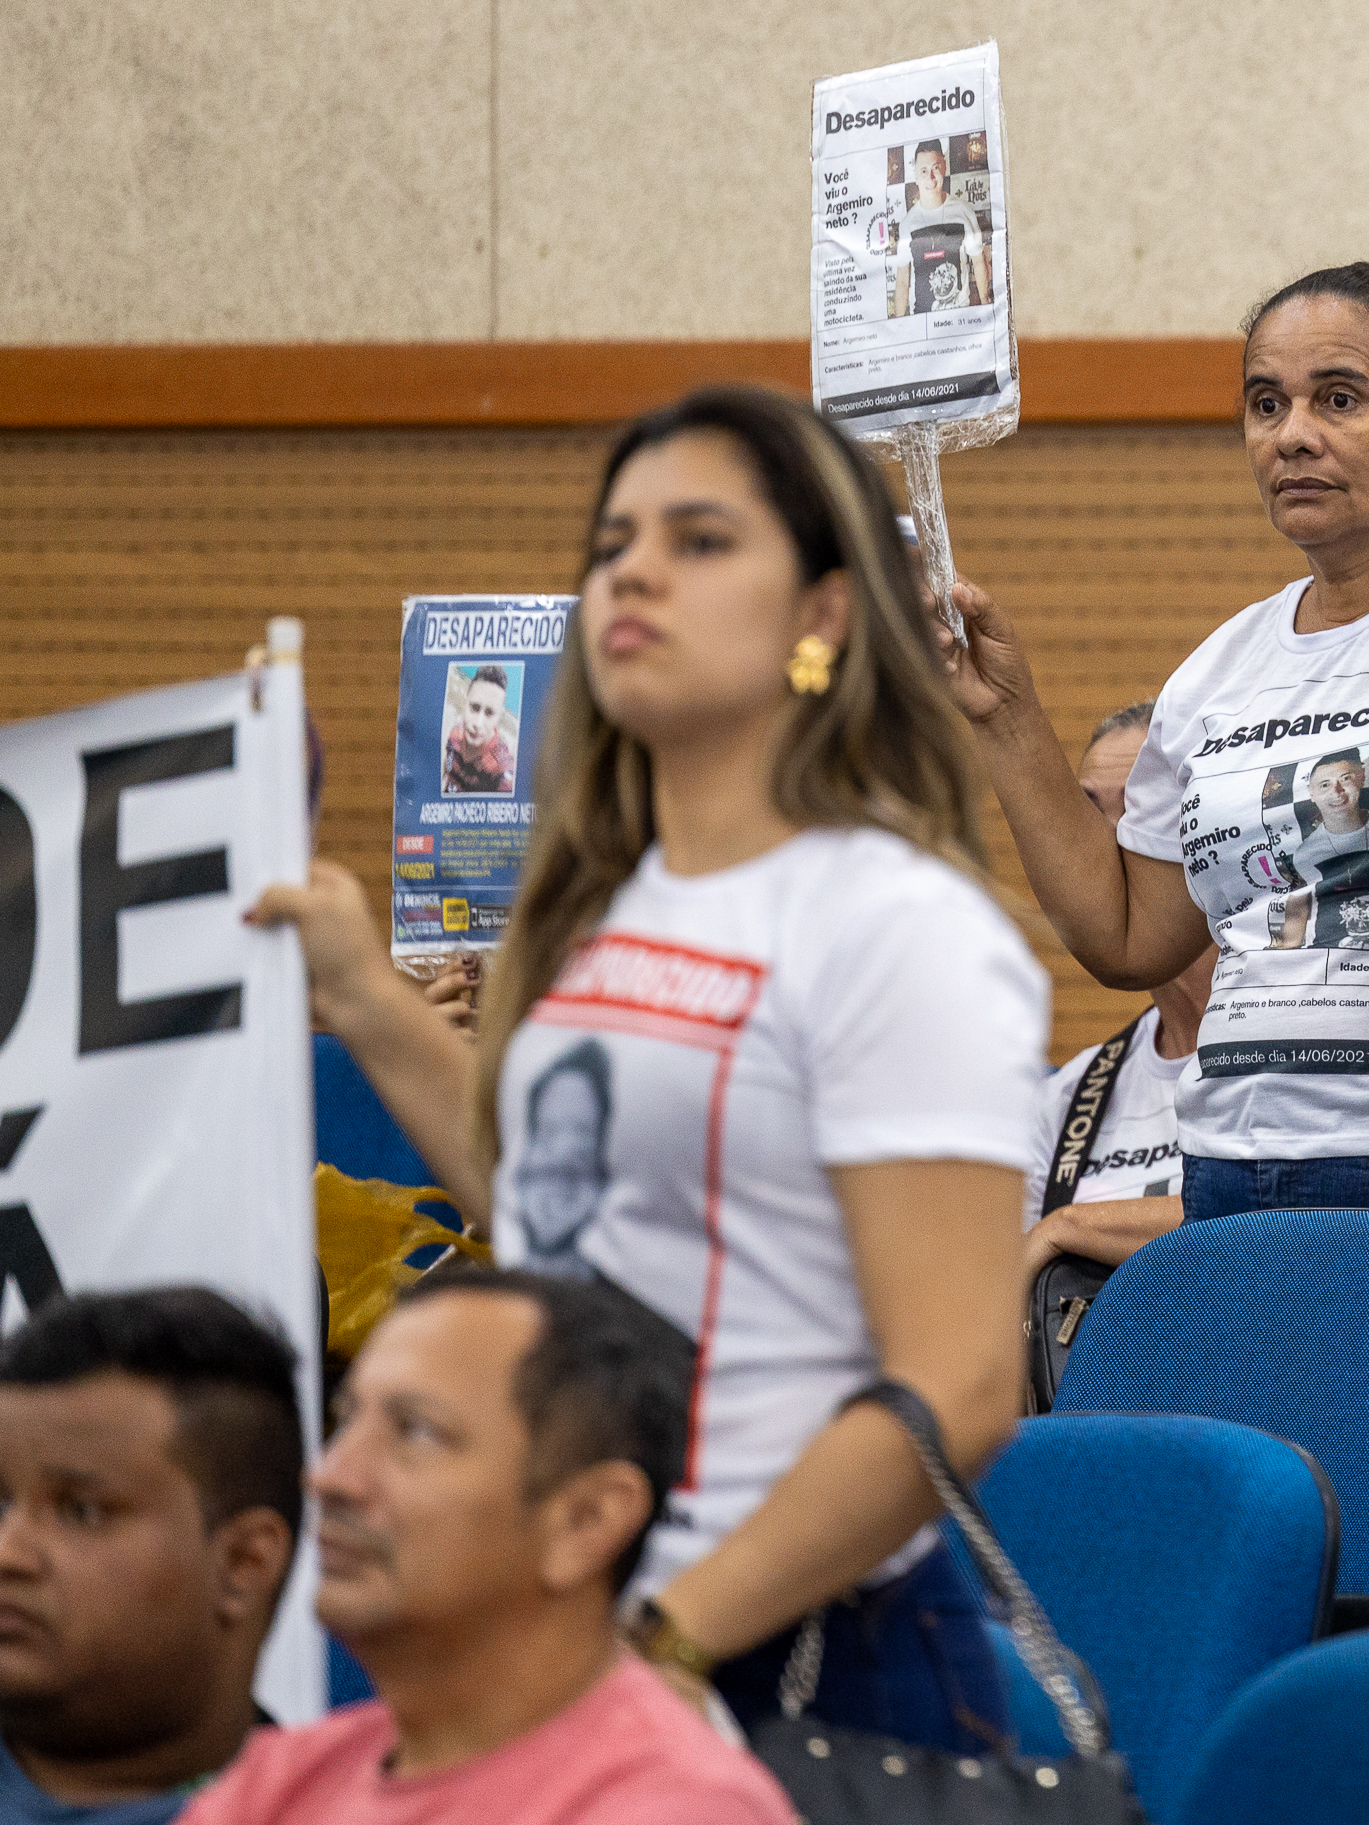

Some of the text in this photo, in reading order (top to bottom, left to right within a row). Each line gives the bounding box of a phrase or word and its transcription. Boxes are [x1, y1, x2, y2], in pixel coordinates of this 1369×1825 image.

[825, 87, 975, 135] Desaparecido
[824, 168, 849, 184] Você
[825, 186, 848, 200] viu o
[826, 196, 873, 216] Argemiro
[826, 216, 849, 229] neto
[824, 308, 836, 316] uma
[828, 384, 959, 414] Desaparecido desde dia 14/06/2021
[425, 616, 565, 650] DESAPARECIDO
[1181, 794, 1200, 818] ocê
[1190, 818, 1198, 831] o
[1208, 850, 1220, 865] ?
[1230, 1000, 1260, 1010] Argemiro
[1268, 998, 1296, 1007] branco
[1228, 1012, 1246, 1022] preto.
[1233, 1051, 1266, 1065] desde
[1268, 1050, 1286, 1063] dia
[1056, 1038, 1124, 1186] PANTONE
